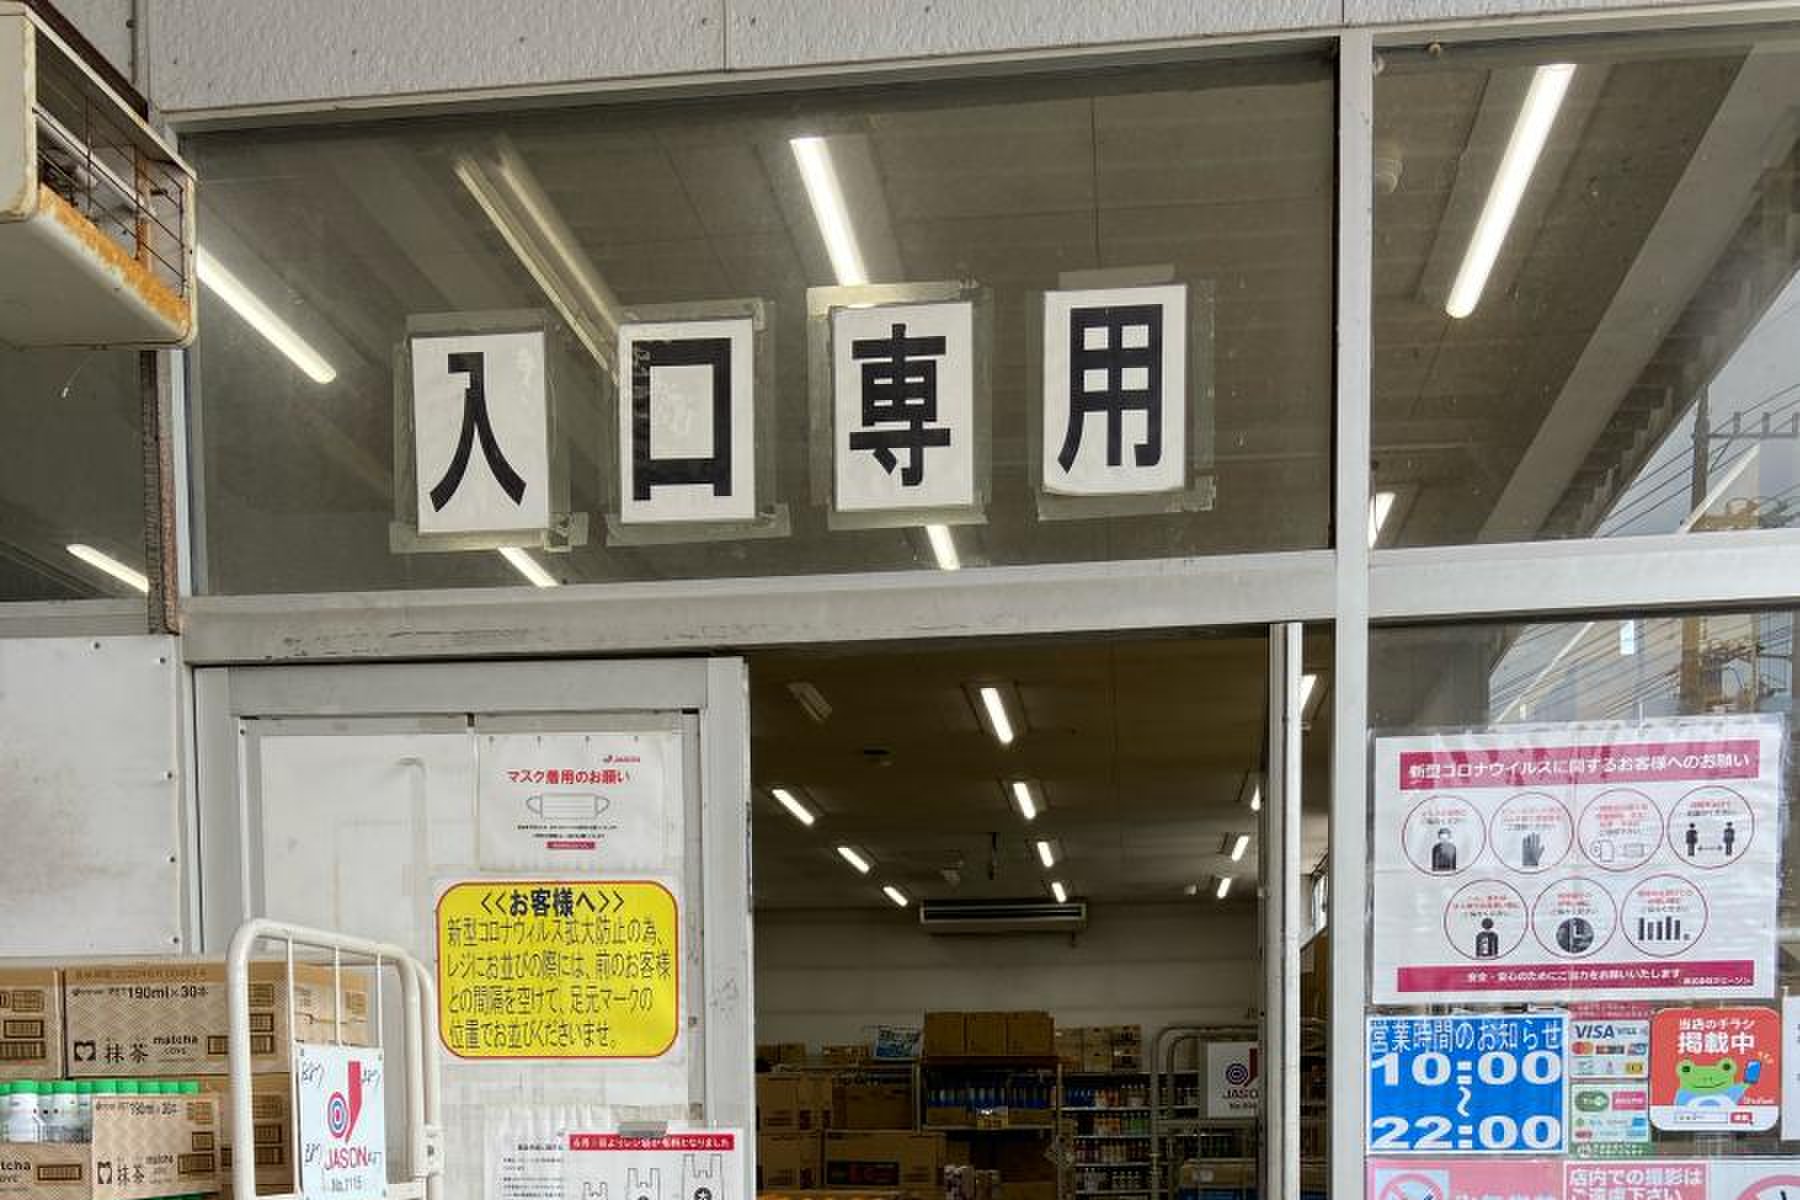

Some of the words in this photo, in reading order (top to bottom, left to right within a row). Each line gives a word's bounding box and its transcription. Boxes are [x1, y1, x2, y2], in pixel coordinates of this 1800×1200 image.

[429, 303, 1165, 513] 入口専用
[1370, 1019, 1562, 1053] 営業時間のお知らせ
[1574, 1025, 1615, 1039] VISA
[1677, 1031, 1755, 1054] 掲載中
[1371, 1050, 1562, 1087] 10:00
[1371, 1114, 1562, 1150] 22:00
[324, 1145, 369, 1171] JASON
[1569, 1167, 1703, 1187] 店内での撮影は
